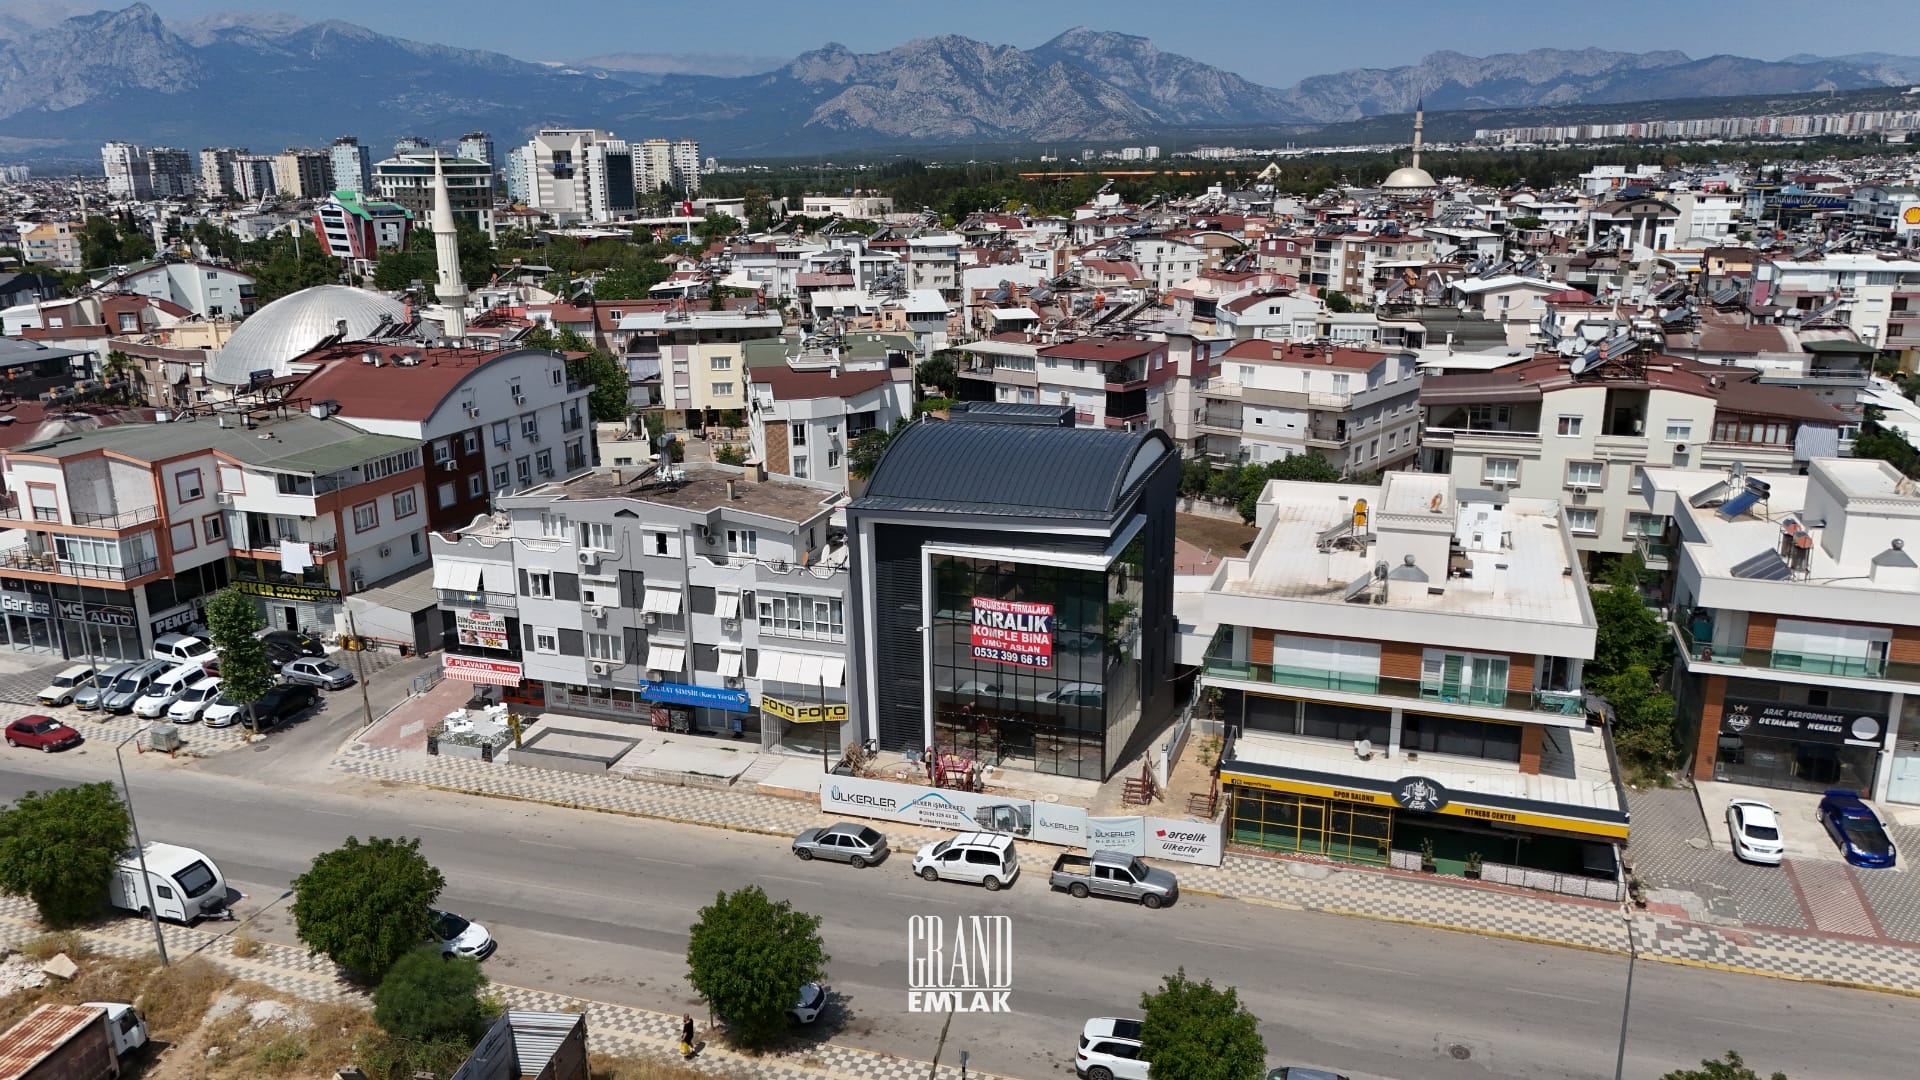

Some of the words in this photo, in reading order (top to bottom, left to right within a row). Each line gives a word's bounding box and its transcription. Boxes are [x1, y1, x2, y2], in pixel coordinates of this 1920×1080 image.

[276, 586, 338, 597] OTOMOTİV
[277, 591, 316, 601] EMLAK
[1, 595, 50, 615] Garage
[59, 601, 84, 619] MS
[973, 598, 1009, 611] KURUMSAL
[90, 611, 131, 626] AUTO
[973, 626, 1018, 642] KOMPLE
[1010, 644, 1041, 654] ASLAN
[974, 646, 999, 659] 0532
[1001, 651, 1018, 662] 399
[1021, 655, 1033, 665] 66
[1035, 656, 1048, 667] 15
[762, 697, 795, 717] FOTO
[798, 706, 846, 718] FOTO
[1351, 792, 1375, 803] SALONU
[1491, 811, 1516, 821] CENTER
[1168, 829, 1208, 844] arçelik
